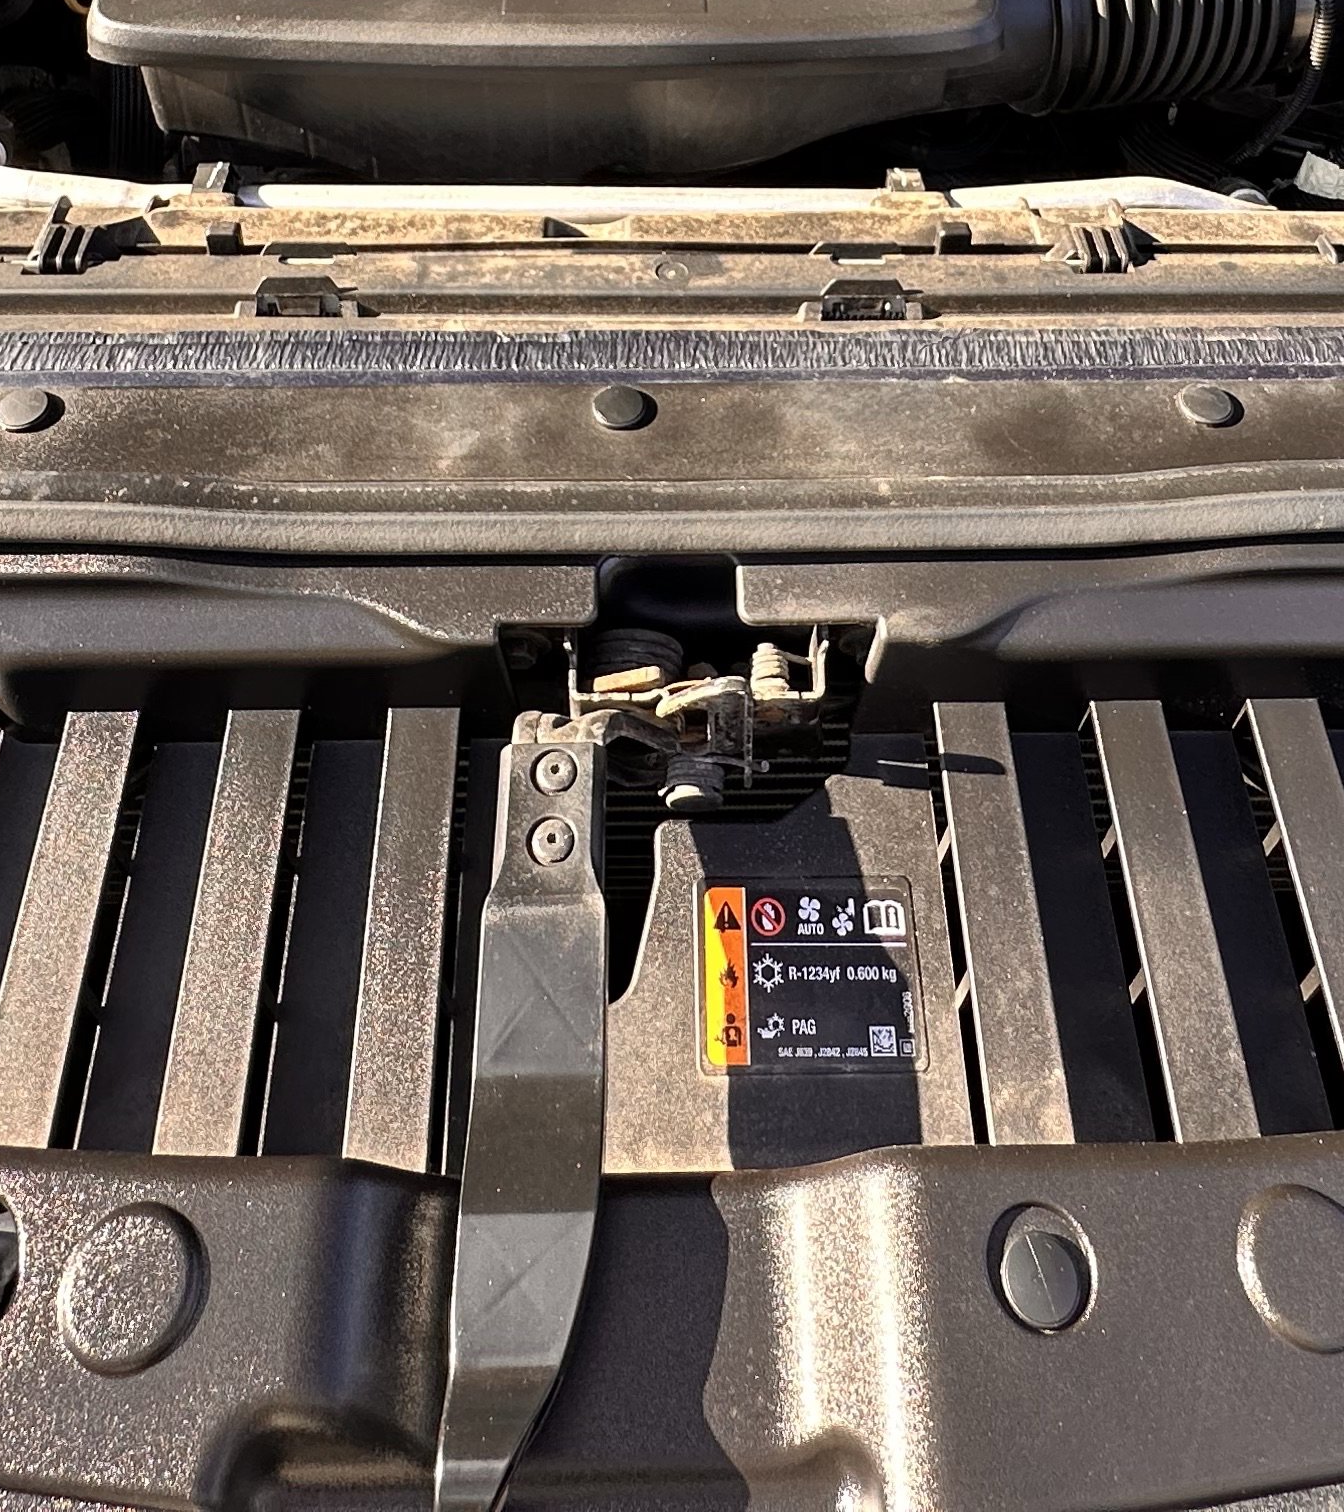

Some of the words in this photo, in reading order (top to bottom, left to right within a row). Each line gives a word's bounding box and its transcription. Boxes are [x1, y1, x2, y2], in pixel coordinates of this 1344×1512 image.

[797, 923, 825, 936] AUTO
[788, 965, 841, 983] R-1234yf
[846, 966, 880, 981] 0.600
[882, 965, 897, 983] kg
[791, 1019, 817, 1035] PAG
